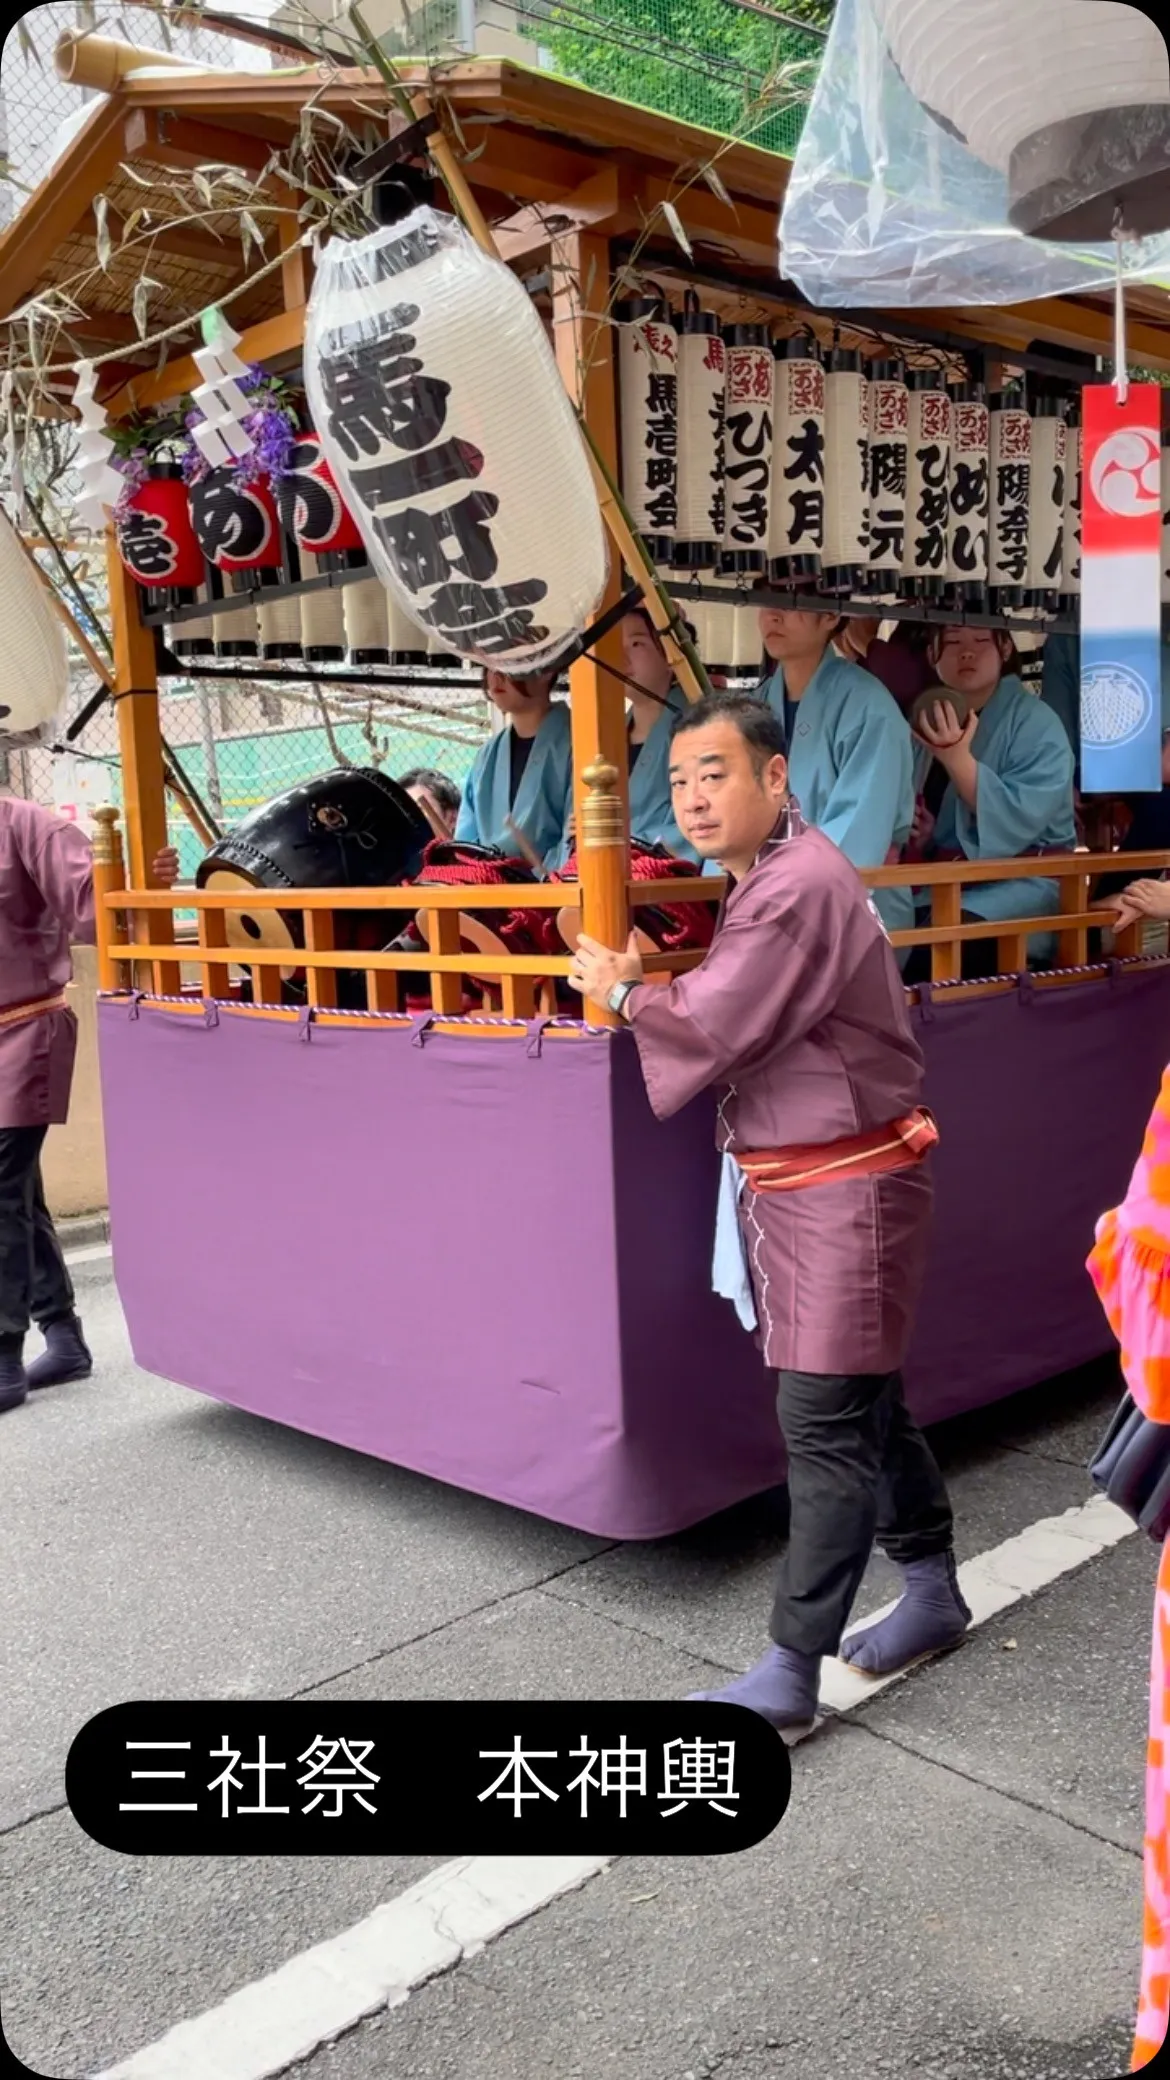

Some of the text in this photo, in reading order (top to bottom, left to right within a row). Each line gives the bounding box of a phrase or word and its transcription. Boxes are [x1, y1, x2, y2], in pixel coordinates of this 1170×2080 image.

[725, 410, 773, 543] ひつき
[915, 445, 950, 569] ひめか
[950, 457, 988, 572] めい
[996, 463, 1030, 580] 陽奈子
